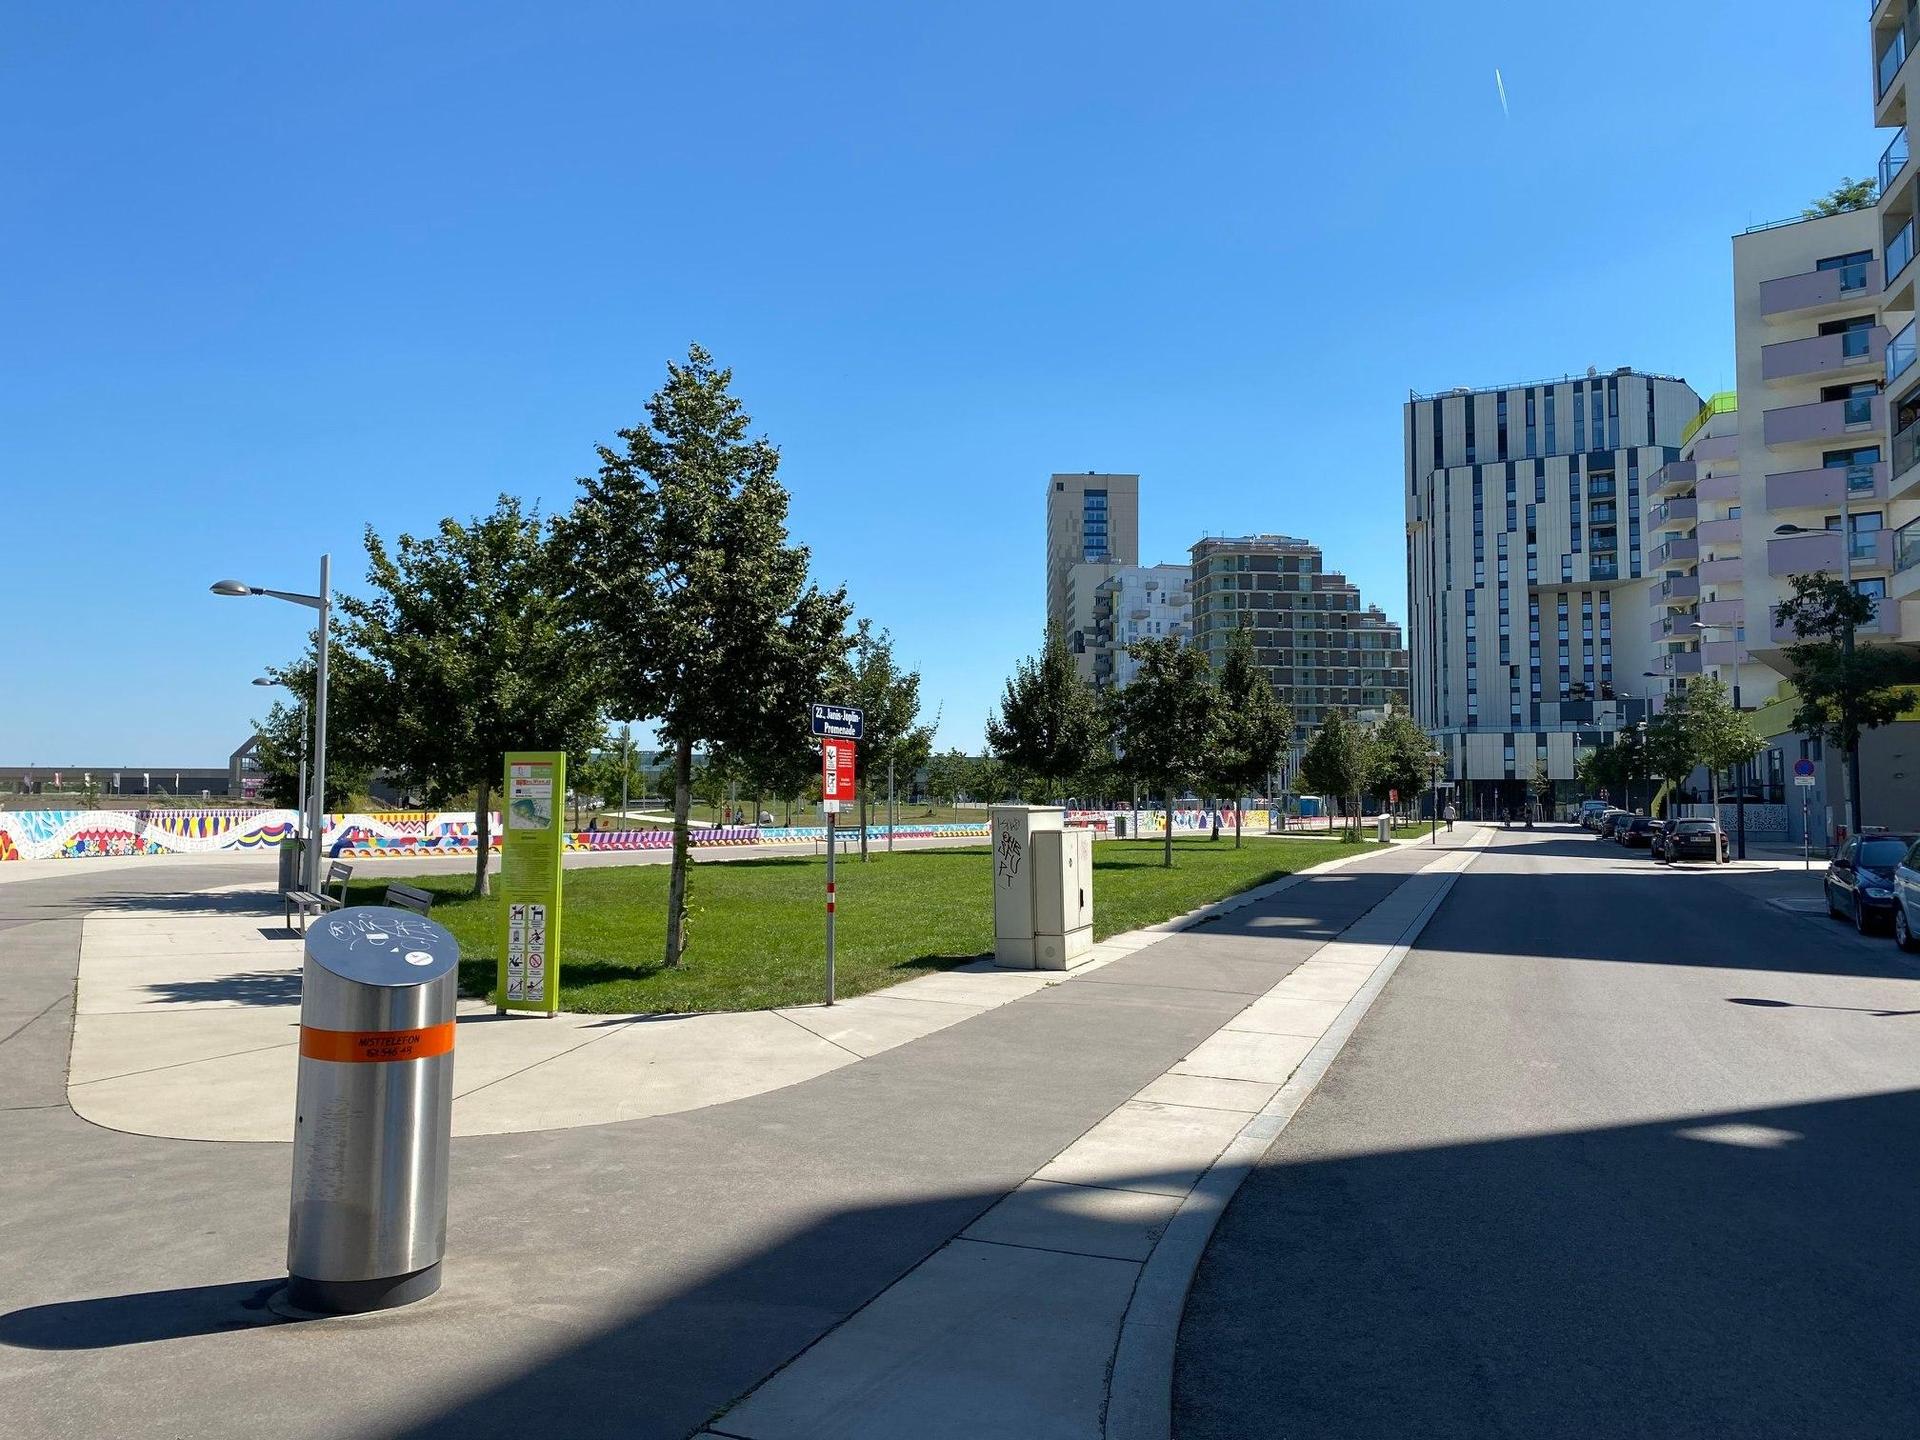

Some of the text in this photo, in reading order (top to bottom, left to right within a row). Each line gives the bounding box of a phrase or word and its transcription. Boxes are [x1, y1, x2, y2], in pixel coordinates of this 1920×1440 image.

[826, 708, 861, 725] Janis-Joplin-
[824, 721, 856, 736] Promenade
[358, 1034, 420, 1047] MISTTELEFON
